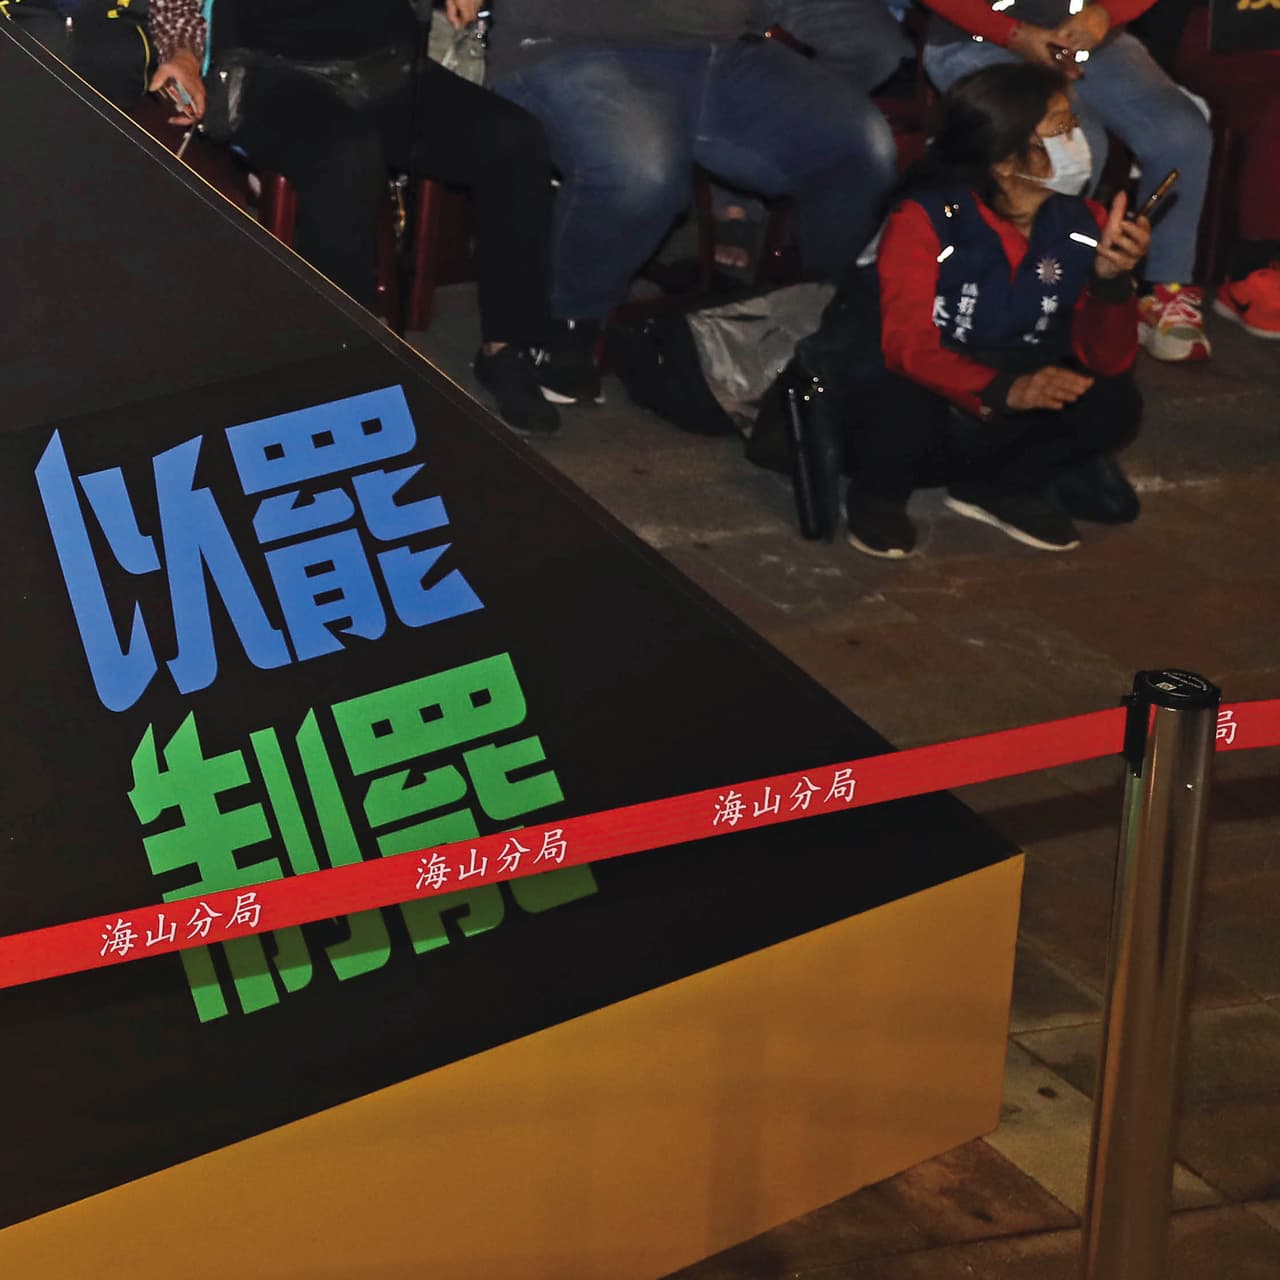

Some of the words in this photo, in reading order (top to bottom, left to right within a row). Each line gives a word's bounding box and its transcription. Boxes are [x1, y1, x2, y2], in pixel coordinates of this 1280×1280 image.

[34, 384, 485, 712] 以罷
[1215, 710, 1237, 745] 局
[712, 767, 857, 827] 海山分局
[127, 652, 598, 1023] 制罷
[415, 827, 568, 891] 海山分局
[99, 891, 262, 958] 海山分局
